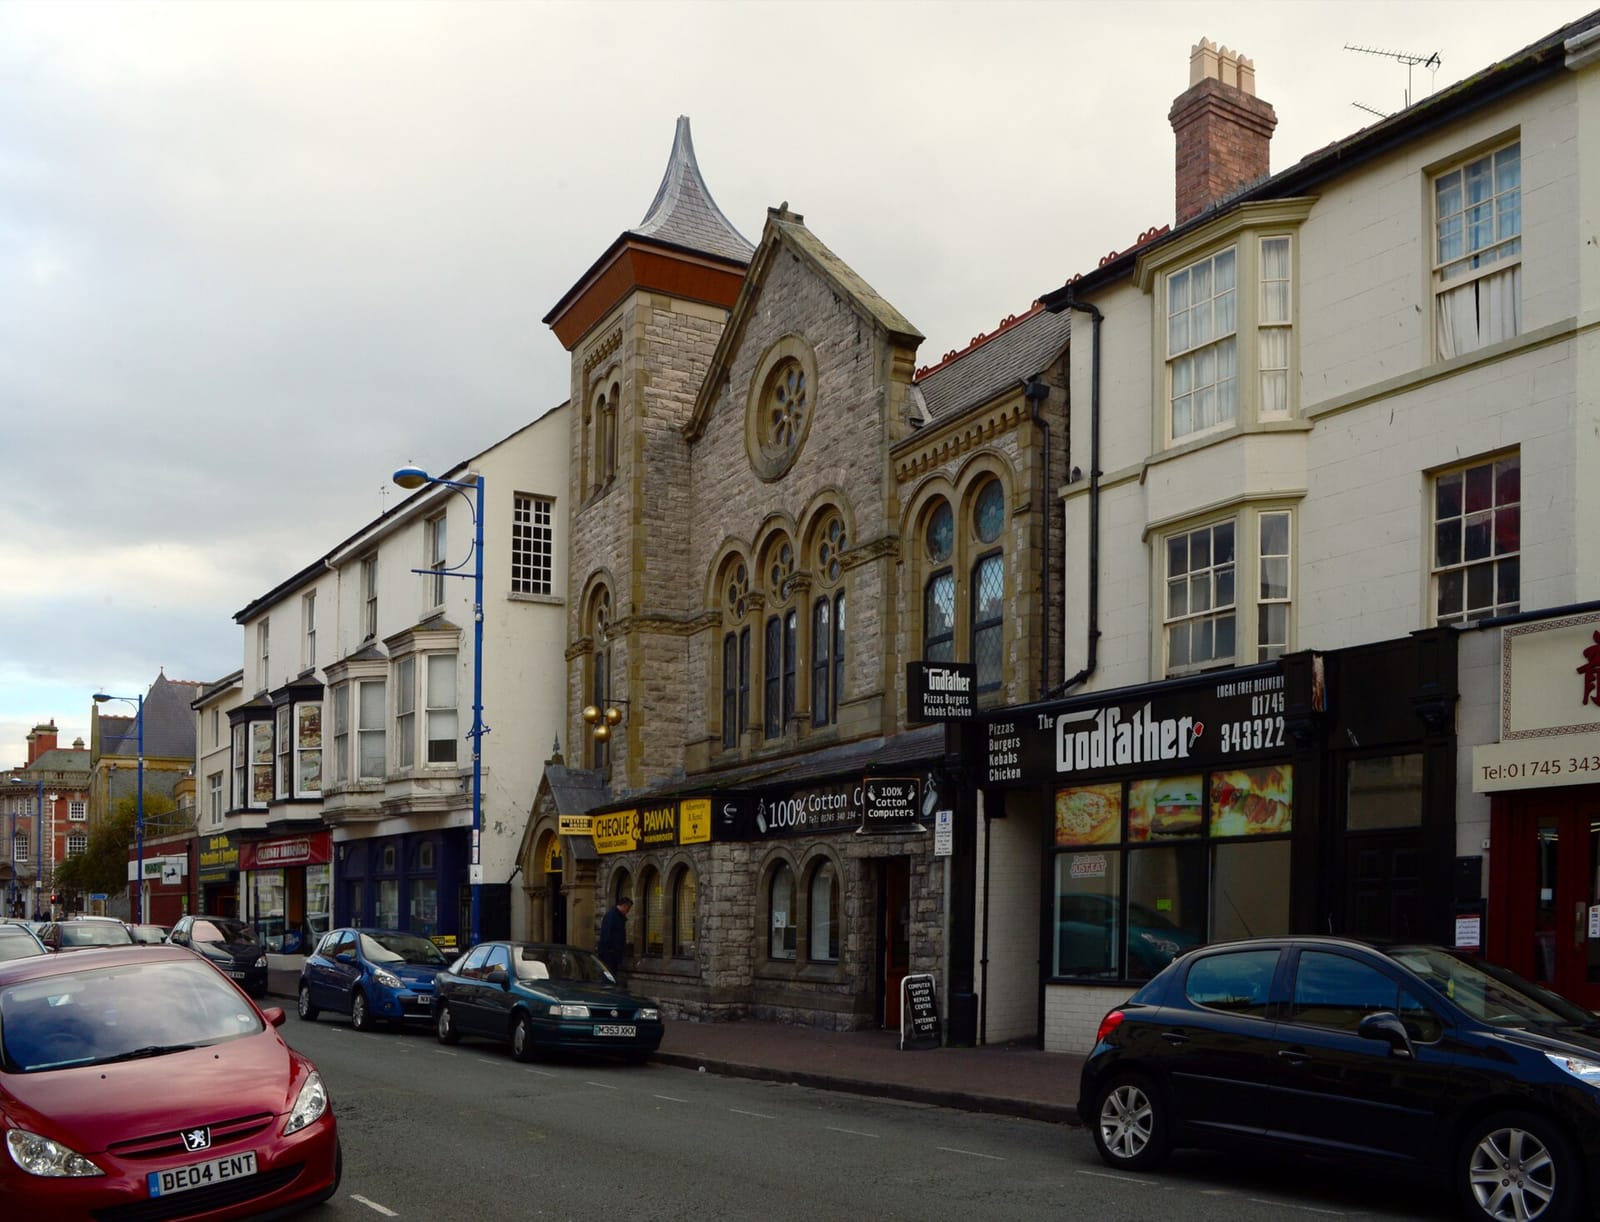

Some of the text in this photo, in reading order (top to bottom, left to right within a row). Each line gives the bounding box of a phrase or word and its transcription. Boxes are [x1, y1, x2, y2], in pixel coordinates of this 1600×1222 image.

[929, 668, 971, 691] Godfather
[1217, 676, 1284, 698] LOCAL FREE DELIVERY
[924, 693, 969, 706] Pizzas Burgers
[1252, 692, 1285, 716] 01745
[924, 706, 973, 717] Kebabs Chicken
[988, 723, 1015, 736] Pizzas
[1038, 701, 1192, 772] The Godfather
[1220, 716, 1285, 753] 343322
[989, 738, 1021, 751] Burgers
[989, 752, 1018, 767] Kebabs
[989, 768, 1021, 782] Chicken
[1482, 760, 1561, 780] Tel:01745
[880, 786, 903, 797] 100%
[875, 798, 907, 807] Cotton
[769, 798, 807, 829] 100%
[808, 793, 848, 812] Cotton
[868, 808, 915, 819] Computers
[596, 807, 675, 841] CHEQUE & PAWN
[908, 982, 930, 990] COMPUTER
[914, 1016, 937, 1025] INTERNET
[163, 1165, 214, 1191] DE04
[218, 1155, 253, 1179] ENT
